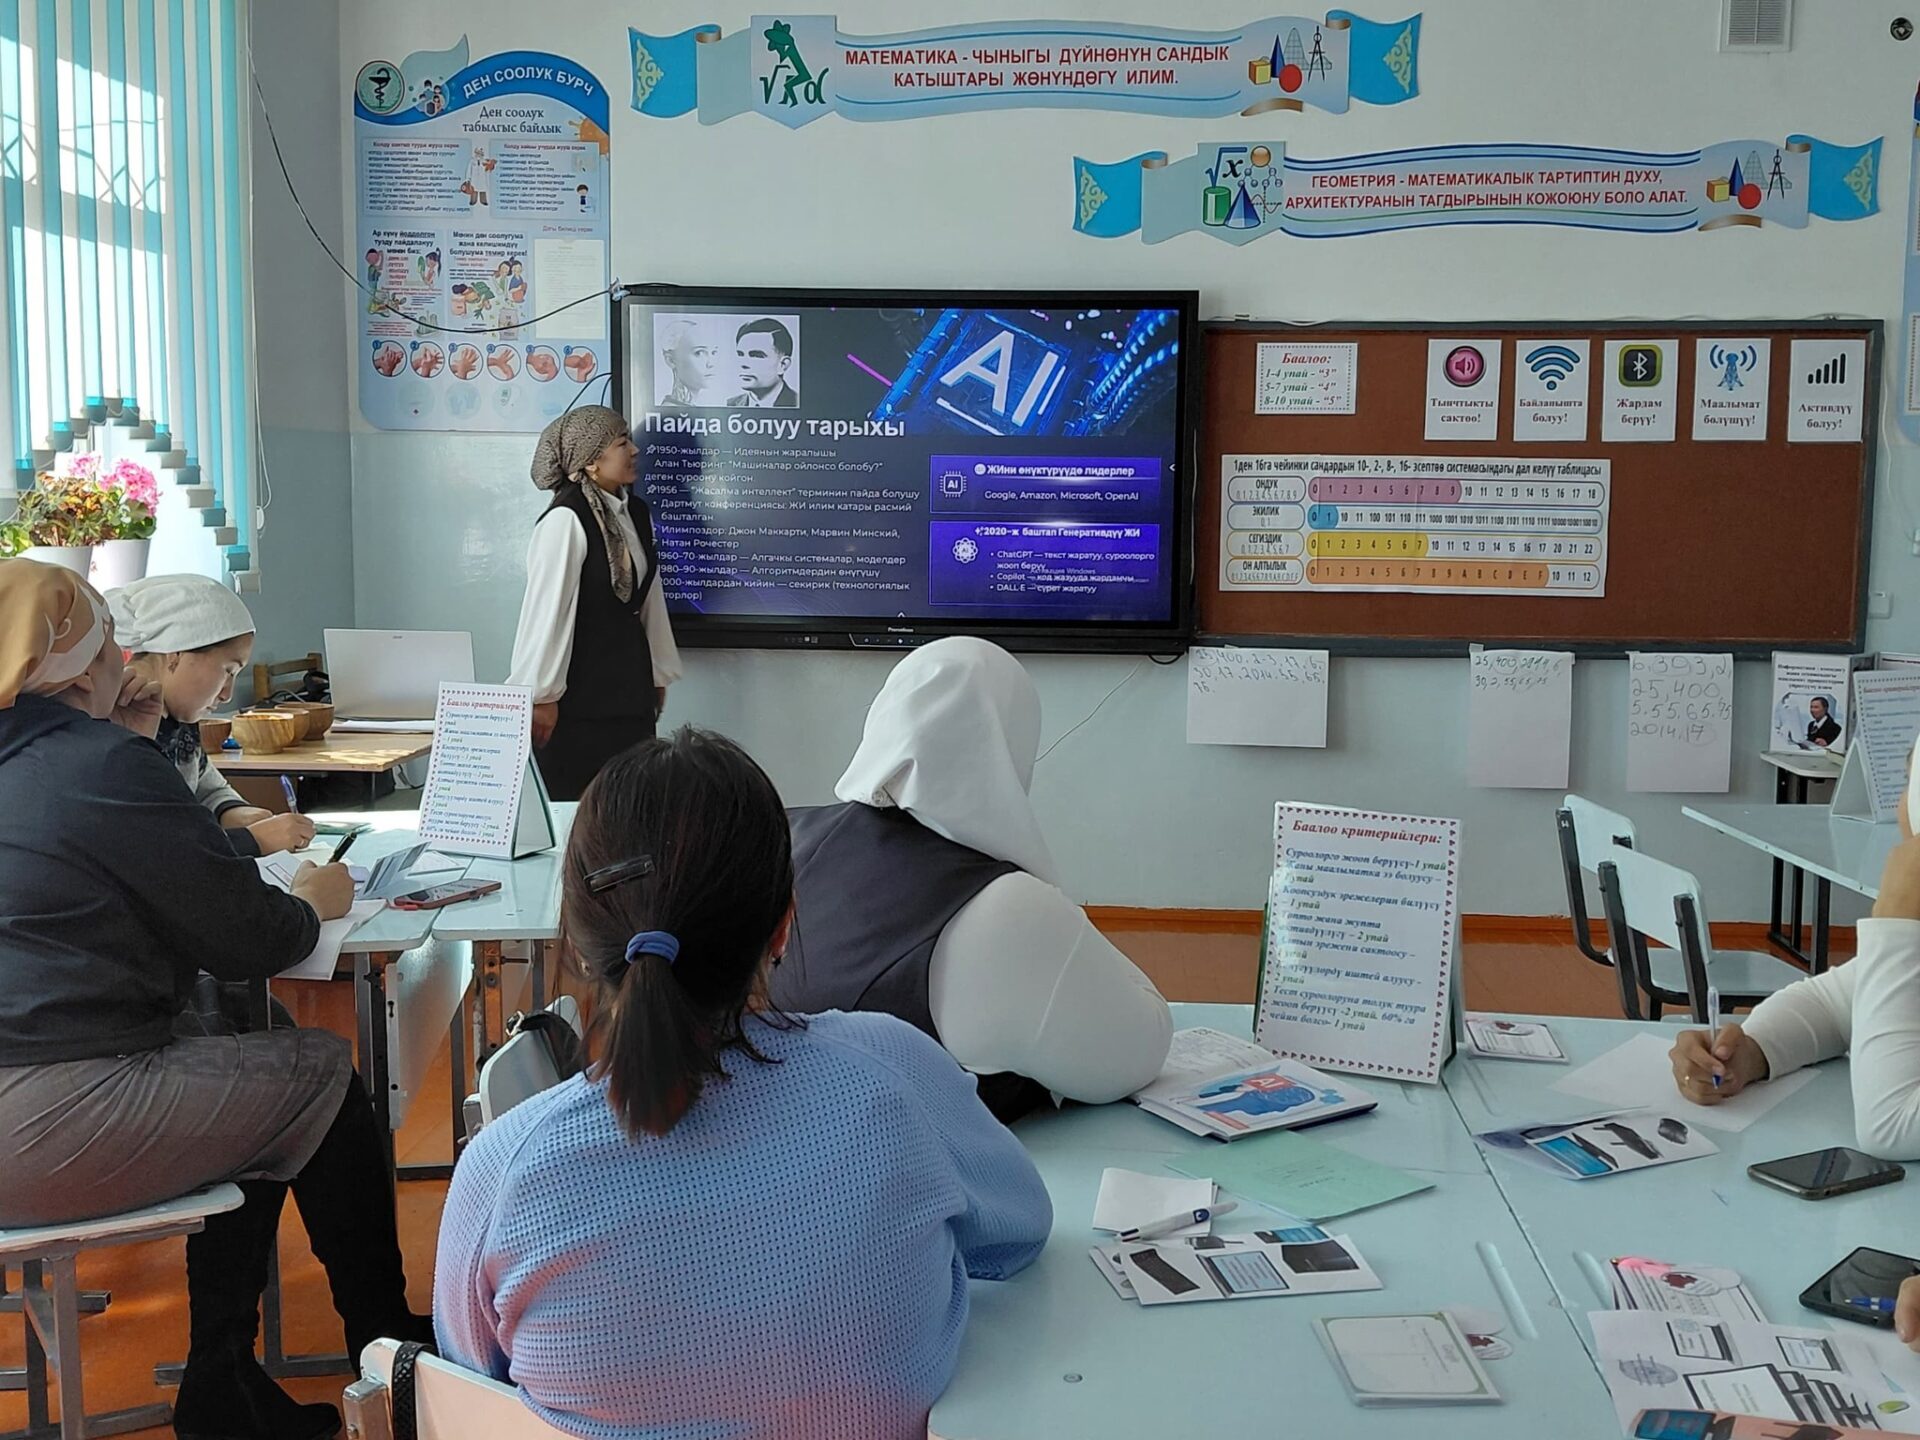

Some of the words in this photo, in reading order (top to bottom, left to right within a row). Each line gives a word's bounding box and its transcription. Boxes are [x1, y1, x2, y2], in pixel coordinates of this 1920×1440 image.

[845, 50, 958, 66] МАТЕМАТИКА
[972, 48, 1051, 65] ЧЫНЫГЫ
[1059, 46, 1152, 66] ДҮЙНӨНҮН
[1157, 45, 1230, 65] САНДЫК
[462, 76, 491, 99] ДЕН
[494, 65, 553, 84] СООЛУК
[556, 71, 594, 96] БУРЧ
[894, 71, 1004, 87] КАТЫШТАРЫ
[1012, 70, 1118, 88] ЖӨНҮНДӨГҮ
[1127, 69, 1179, 85] ИЛИМ.
[479, 105, 504, 120] Ден
[506, 108, 544, 120] соолук
[462, 121, 517, 134] табылгыс
[519, 121, 562, 134] байлык
[1311, 174, 1396, 189] ГЕОМЕТРИЯ
[1407, 171, 1535, 187] МАТЕМАТИКАЛЫК
[1537, 170, 1621, 185] ТАРТИПТИН
[1623, 170, 1663, 187] ДУХУ,
[1285, 194, 1415, 209] АРХИТЕКТУРАНЫН
[1419, 192, 1523, 209] ТАГДЫРЫНЫН
[1526, 191, 1601, 206] КОЖОЮНУ
[1604, 191, 1645, 204] БОЛО
[1648, 189, 1688, 203] АЛАТ.
[1282, 352, 1332, 365] Баалоо:
[939, 330, 1059, 427] AI
[1283, 369, 1308, 380] упай
[1282, 382, 1307, 393] упай
[1287, 396, 1313, 407] упай
[1430, 397, 1494, 408] Тынчтыкты
[1519, 397, 1583, 408] Байланышта
[1617, 398, 1662, 410] Жардам
[1700, 398, 1761, 409] Маалымат
[1798, 403, 1853, 414] Активдүү
[1441, 413, 1481, 423] сактоо!
[1532, 413, 1568, 424] болуу!
[645, 412, 722, 438] Пайда
[727, 415, 800, 440] болуу
[807, 417, 905, 440] тарыхы
[656, 446, 720, 457] 1950-жылдар
[734, 447, 780, 457] Идеянын
[782, 449, 837, 458] жаралышы
[654, 459, 680, 468] Алан
[682, 459, 724, 470] Тьюринг
[793, 462, 836, 471] ойлонсо
[1273, 459, 1309, 471] чейинки
[1310, 459, 1355, 474] сандардын
[1515, 463, 1531, 475] дал
[1557, 463, 1602, 477] таблицасы
[1084, 466, 1135, 477] лидерлер
[644, 474, 674, 483] деген
[675, 474, 717, 484] суроону
[719, 473, 753, 483] койгон
[947, 479, 959, 489] AI
[1255, 479, 1279, 490] ОНДУК
[656, 485, 678, 495] 1956
[798, 489, 848, 499] терминин
[850, 489, 880, 499] пайда
[882, 490, 920, 501] болушу
[984, 490, 1018, 501] Google,
[1020, 490, 1058, 501] Amazon,
[1060, 491, 1104, 502] Microsoft,
[1105, 491, 1139, 502] OpenAI
[661, 499, 703, 510] Дартмут
[789, 501, 804, 511] ЖИ
[805, 502, 835, 512] илим
[837, 503, 872, 513] катары
[874, 502, 912, 513] расмий
[1252, 506, 1280, 516] ЭКИЛИК
[661, 512, 714, 522] башталган
[661, 526, 727, 537] Илимпоздор:
[728, 527, 756, 537] Джон
[758, 528, 809, 538] Маккарти,
[811, 528, 850, 538] Марвин
[852, 528, 901, 539] Минский,
[661, 539, 691, 549] Натан
[693, 540, 739, 550] Рочестер
[1248, 533, 1282, 545] СЕГИЗДИК
[751, 553, 793, 563] Алгачкы
[794, 555, 855, 565] системалар,
[857, 555, 906, 566] моделдер
[997, 550, 1033, 559] ChatGPT
[1242, 561, 1253, 571] ОН
[997, 573, 1026, 582] Copilot
[789, 580, 831, 591] секирик
[1293, 820, 1338, 836] Баалоо
[1341, 827, 1442, 845] критерийлери:
